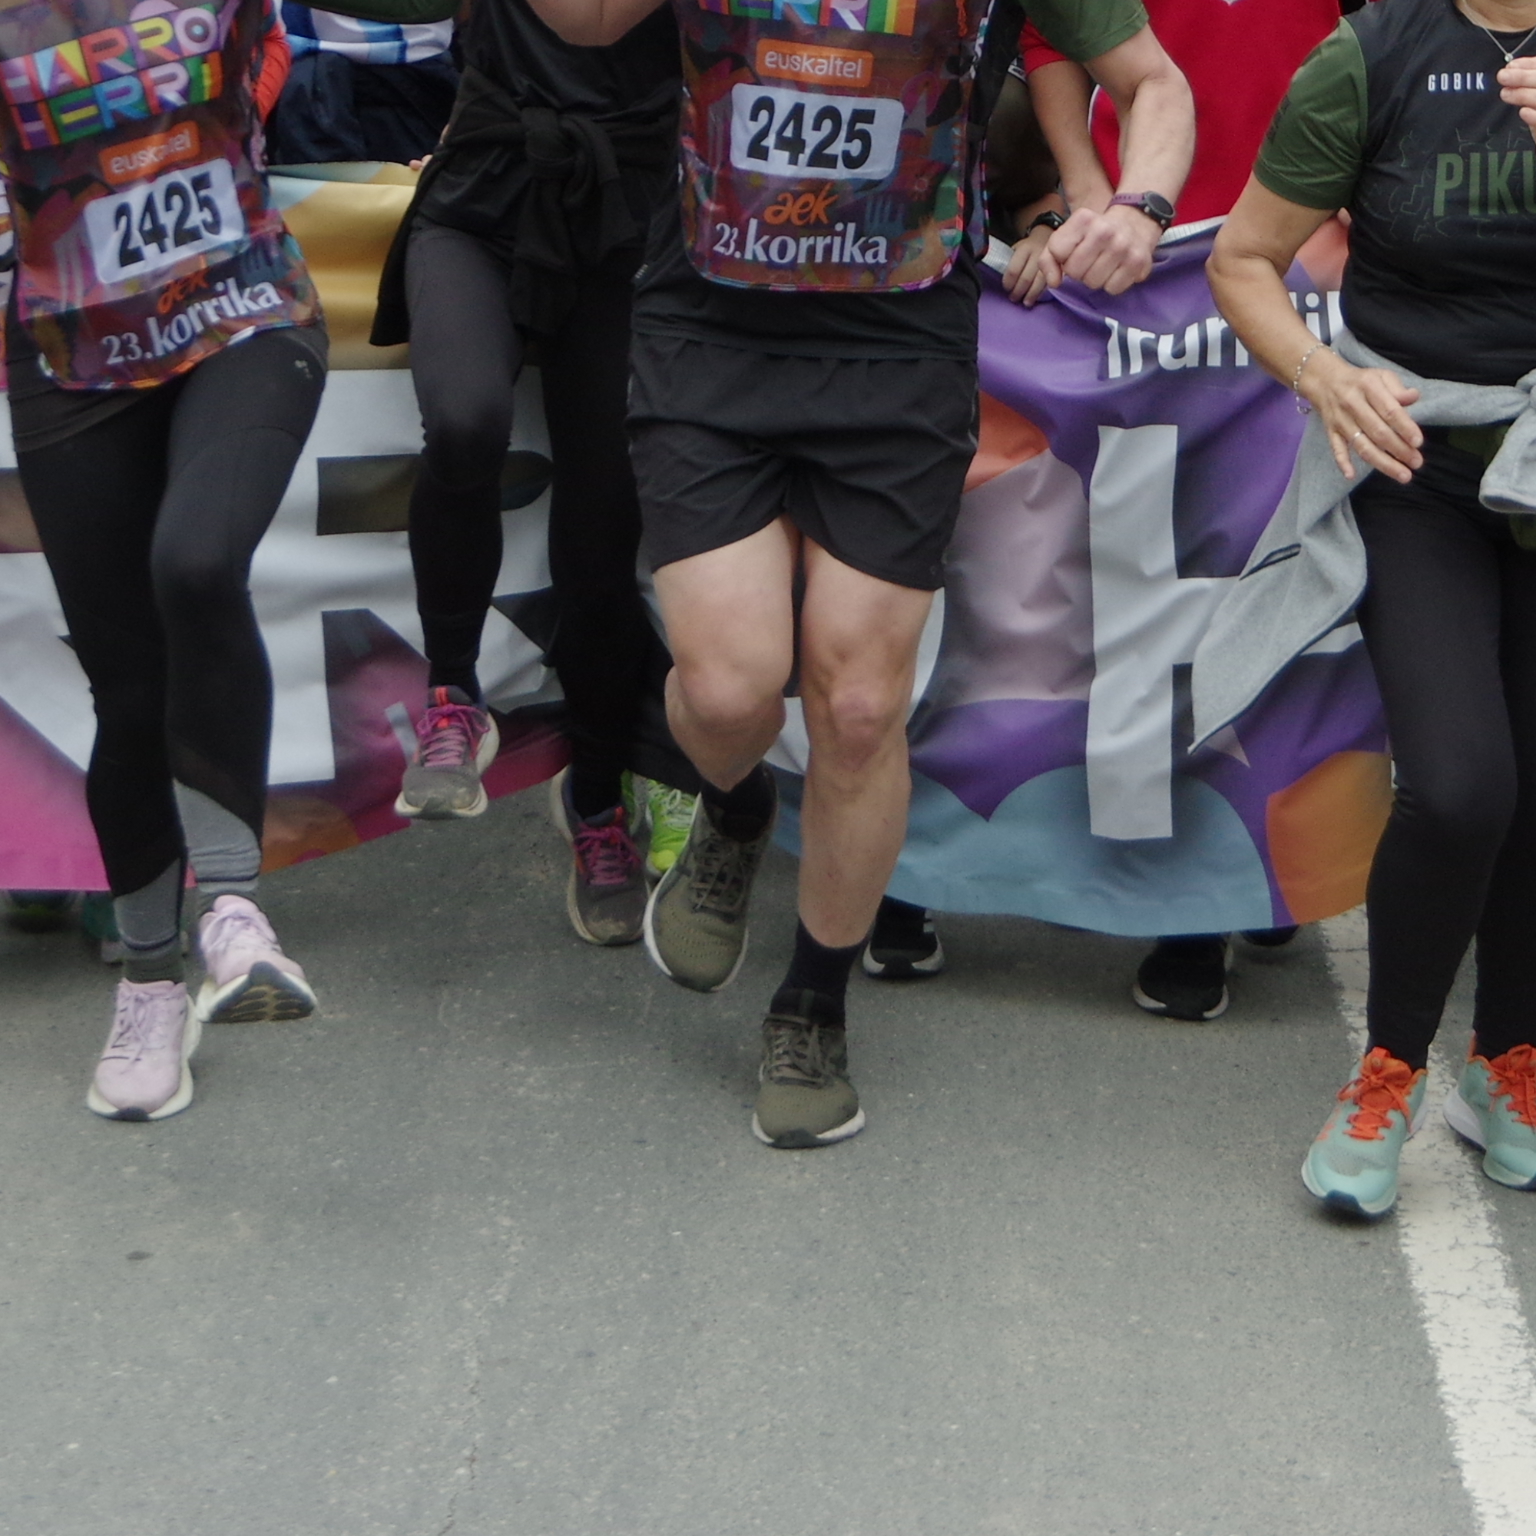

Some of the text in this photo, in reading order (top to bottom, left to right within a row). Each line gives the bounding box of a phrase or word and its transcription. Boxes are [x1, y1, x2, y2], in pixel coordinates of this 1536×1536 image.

[763, 49, 863, 80] euskaltel
[1427, 72, 1486, 93] GOBIK
[10, 50, 224, 152] HERRI
[745, 94, 876, 170] 2425
[113, 170, 222, 269] 2425
[763, 180, 840, 227] aek
[712, 217, 888, 265] 23.korrika
[102, 276, 284, 365] 23.korrika
